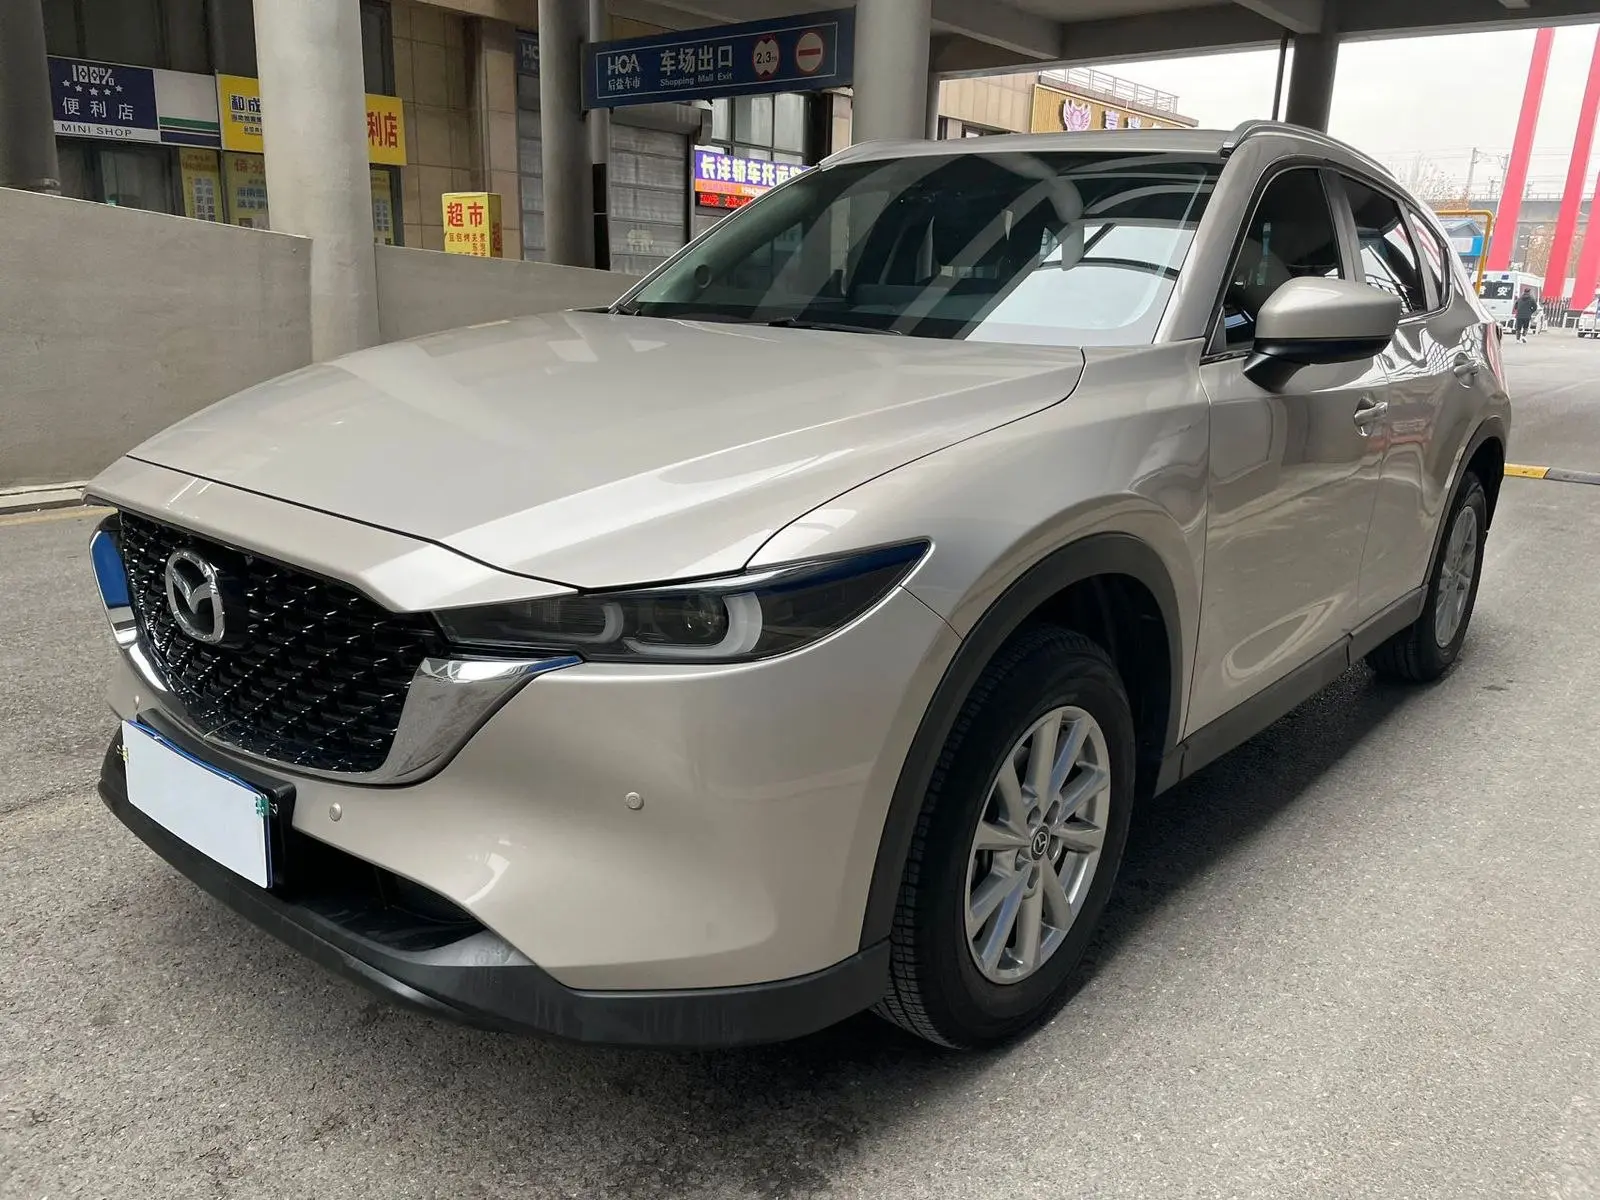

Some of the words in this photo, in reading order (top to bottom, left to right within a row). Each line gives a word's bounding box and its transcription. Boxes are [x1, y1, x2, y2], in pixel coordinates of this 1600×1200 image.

[607, 54, 640, 75] HOA
[660, 45, 733, 75] 车场出口
[72, 65, 115, 86] 100%
[660, 77, 695, 87] Shopping
[697, 74, 714, 83] Mall
[717, 71, 733, 80] Exit
[62, 97, 134, 120] 便利店
[61, 124, 91, 133] MINI
[96, 128, 132, 137] SHOP
[366, 111, 398, 148] 利店
[447, 201, 484, 227] 超市
